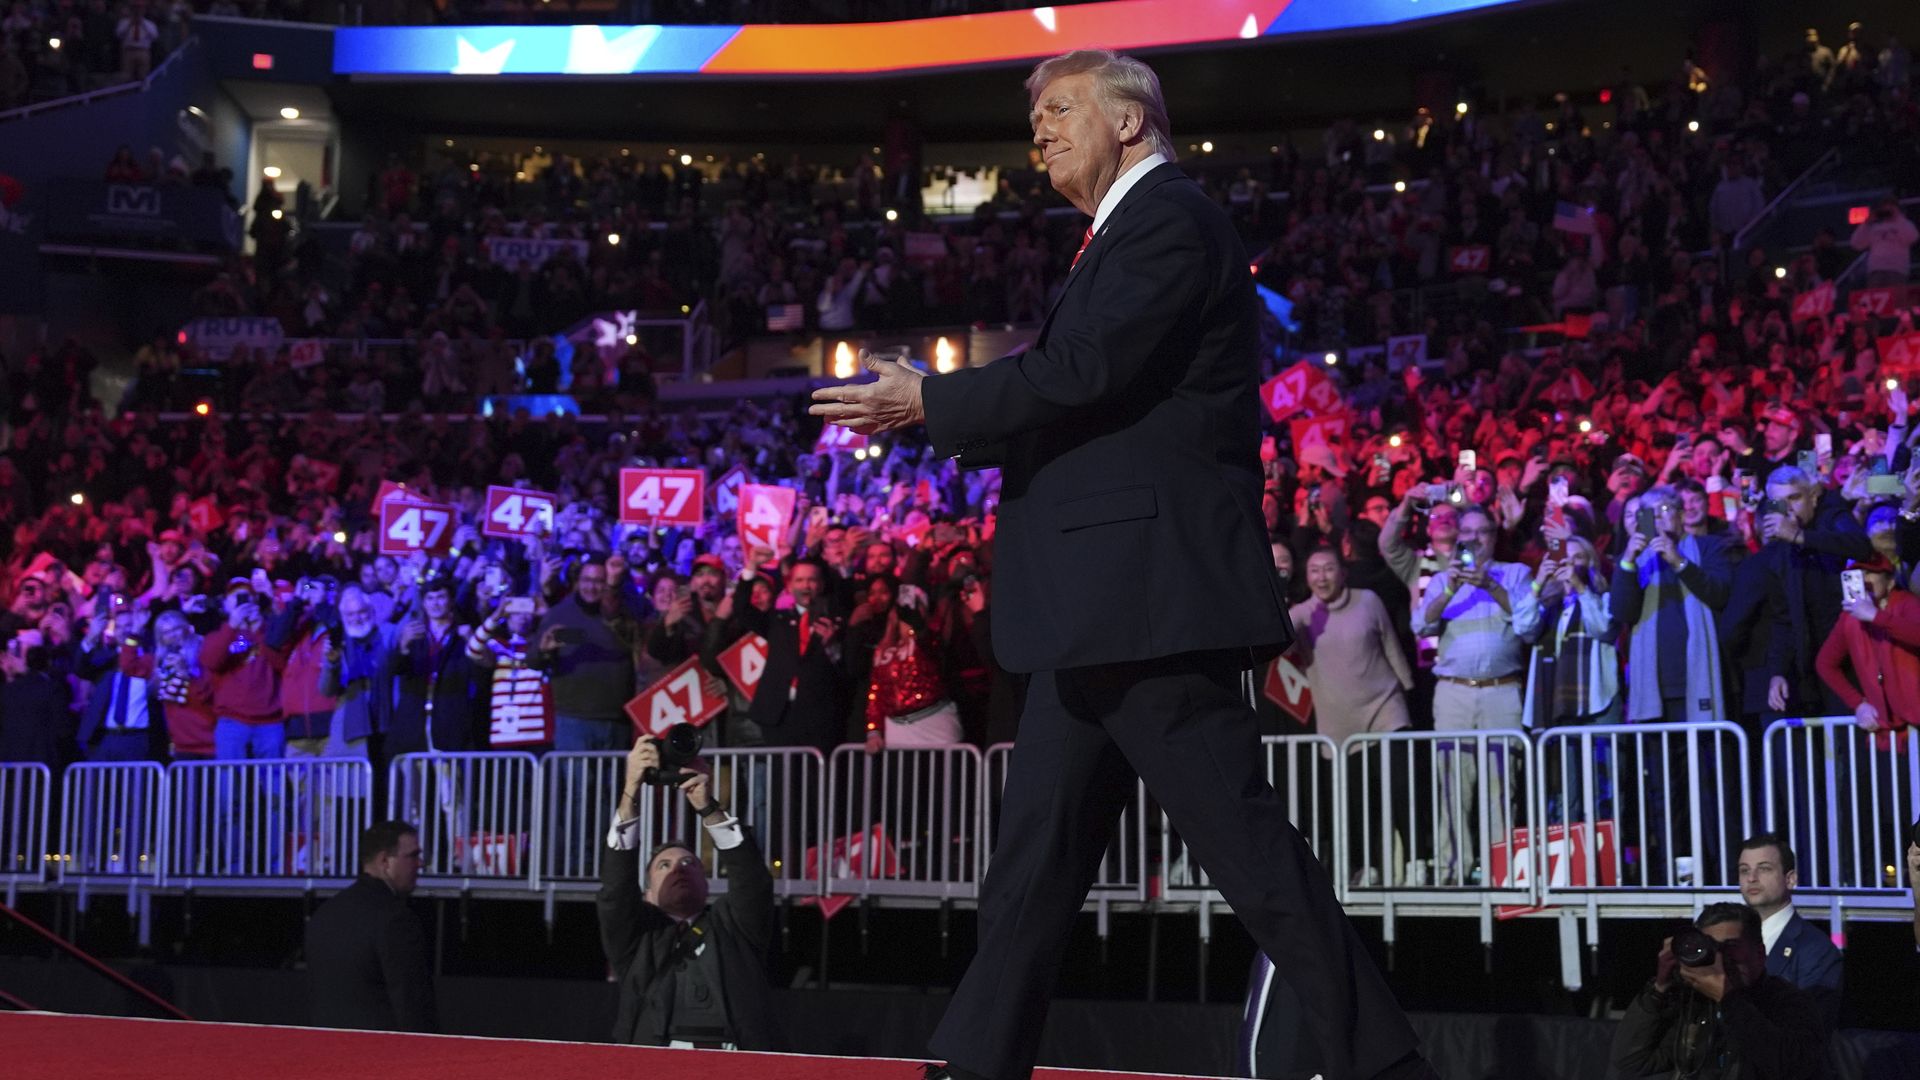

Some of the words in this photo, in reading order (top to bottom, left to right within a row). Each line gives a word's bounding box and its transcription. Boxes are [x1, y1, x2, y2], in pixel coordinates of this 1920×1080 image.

[1455, 249, 1485, 269] 47
[1798, 286, 1830, 316] 47
[1272, 368, 1307, 409] 47
[492, 494, 553, 533] 47
[628, 475, 696, 518] 47
[387, 507, 450, 549] 47
[650, 667, 703, 734] 47
